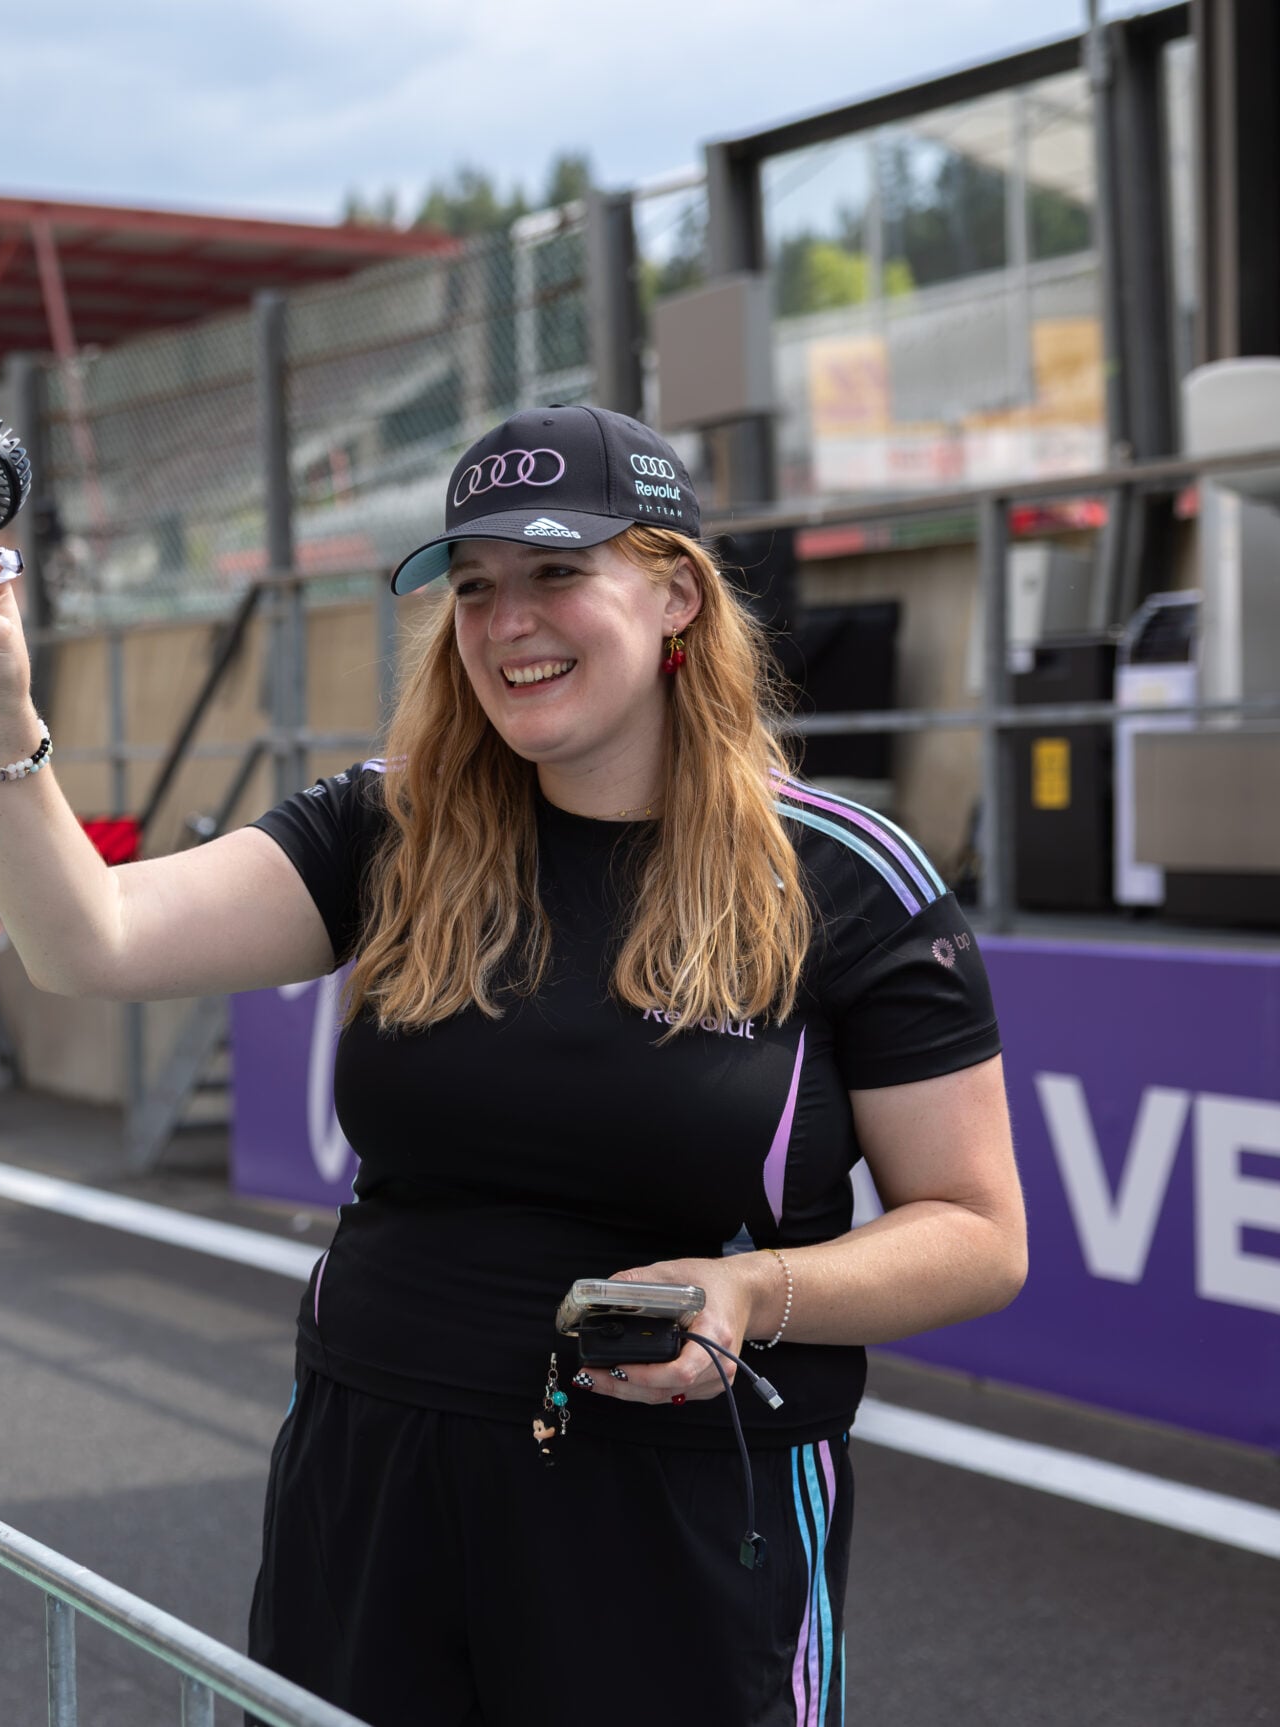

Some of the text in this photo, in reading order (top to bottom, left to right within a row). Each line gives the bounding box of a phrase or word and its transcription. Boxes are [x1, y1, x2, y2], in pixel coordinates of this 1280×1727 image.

[635, 480, 681, 501] Revolut
[657, 506, 682, 517] TEAM
[523, 528, 581, 539] adidas
[953, 932, 971, 951] bp
